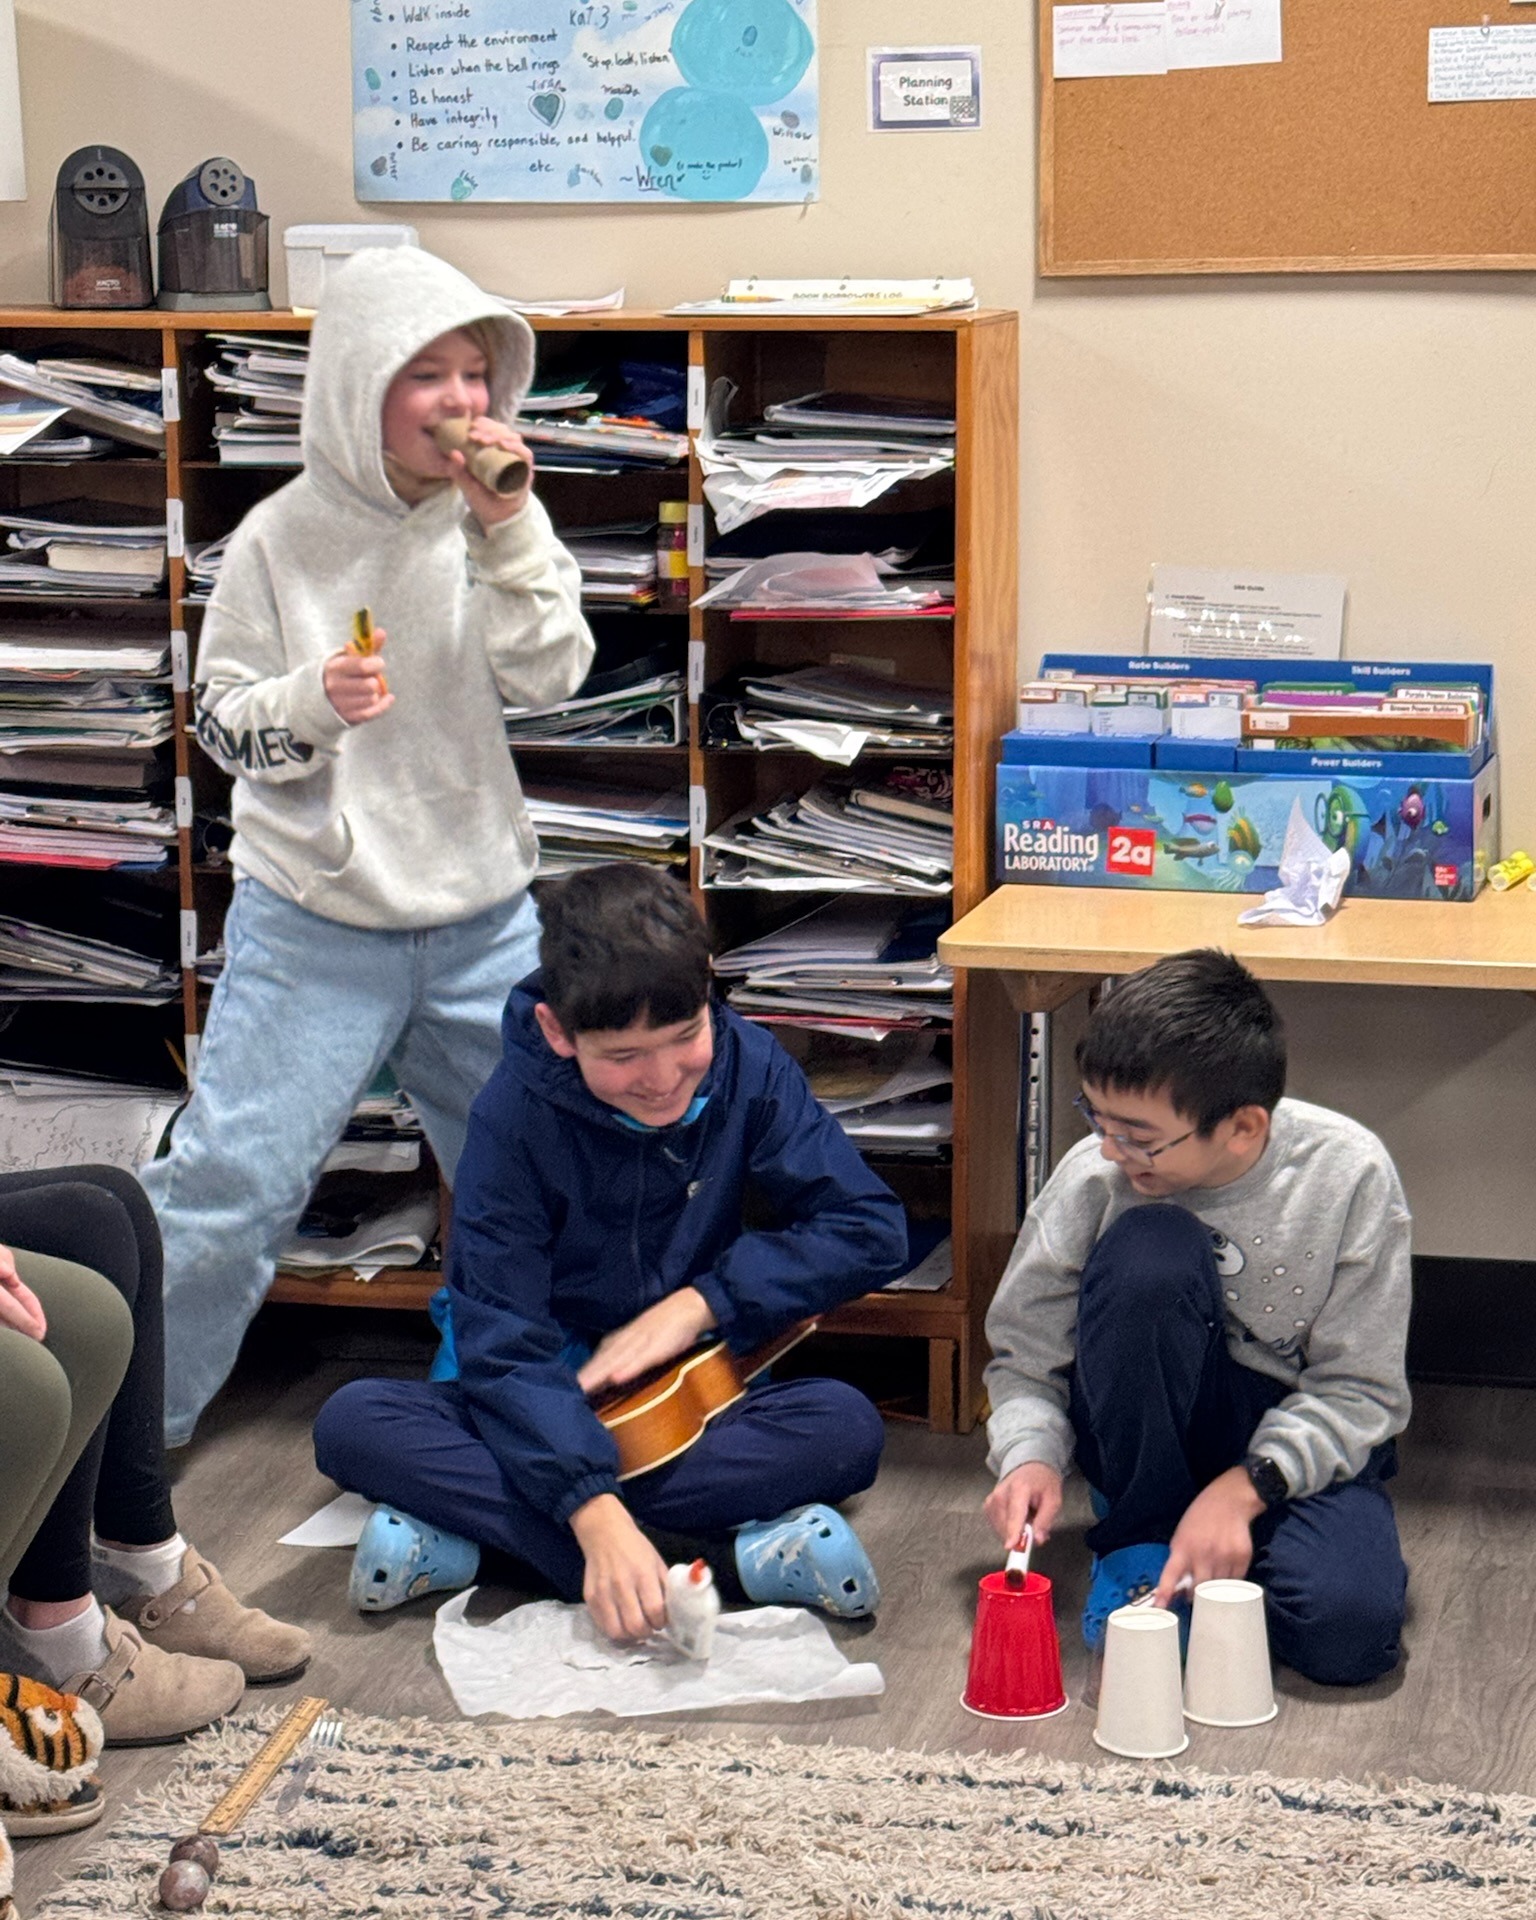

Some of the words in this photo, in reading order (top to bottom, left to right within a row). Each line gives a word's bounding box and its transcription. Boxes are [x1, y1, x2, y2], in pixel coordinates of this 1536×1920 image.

[435, 4, 471, 19] inside
[406, 33, 453, 55] Respect
[457, 33, 478, 49] the
[484, 29, 558, 46] environment
[408, 62, 444, 78] Listen
[450, 58, 481, 76] when
[484, 57, 503, 73] the
[506, 55, 528, 73] bell
[531, 56, 560, 76] rings
[899, 75, 953, 91] Planning
[409, 88, 428, 106] Be
[431, 86, 474, 105] honest
[903, 93, 949, 107] Station
[410, 112, 438, 129] Have
[445, 106, 499, 129] integrity
[411, 136, 429, 152] Be
[567, 132, 588, 145] and
[1153, 661, 1190, 671] Builders
[1351, 666, 1371, 676] Skill
[1373, 667, 1411, 677] Builders
[1311, 756, 1341, 768] Power
[1342, 757, 1382, 769] Builders
[1022, 820, 1054, 831] SRA
[1004, 822, 1099, 861] Reading
[1111, 835, 1152, 867] 2a
